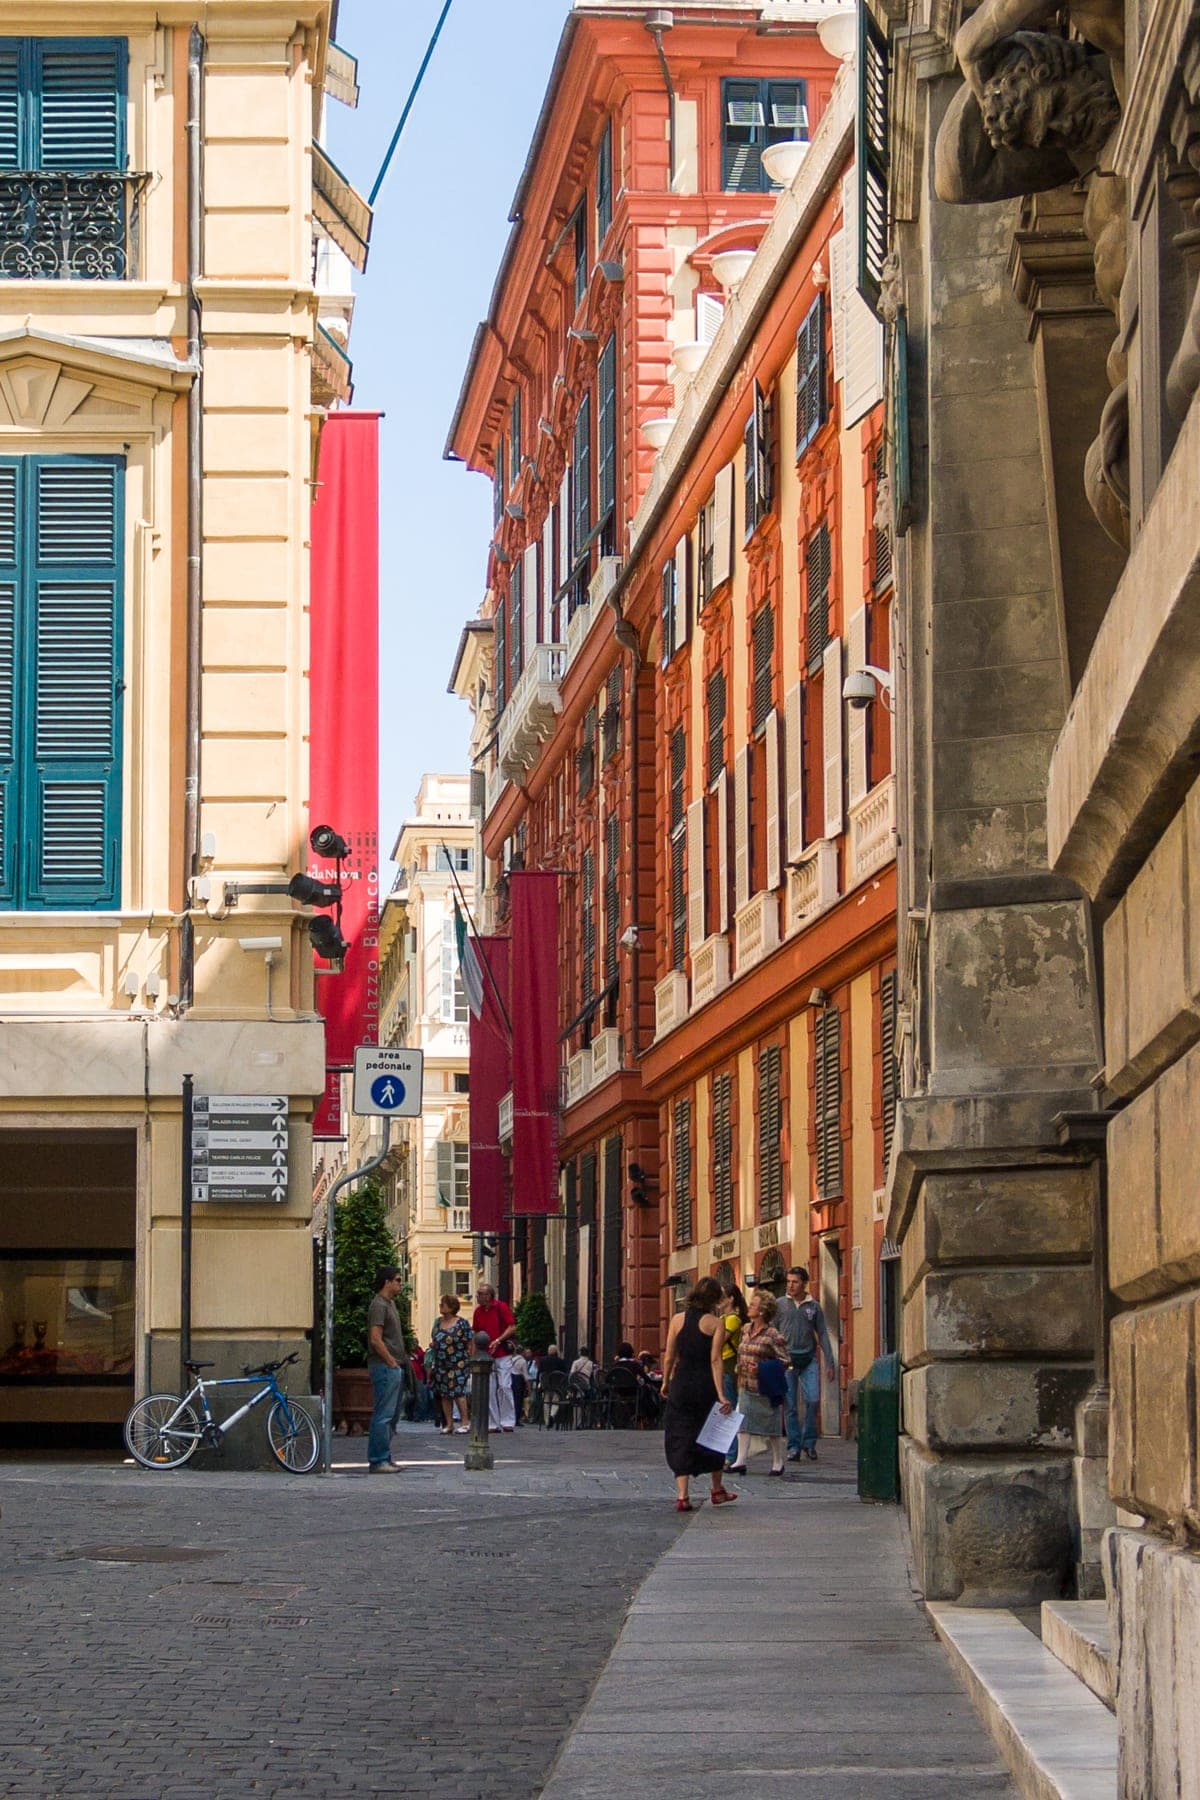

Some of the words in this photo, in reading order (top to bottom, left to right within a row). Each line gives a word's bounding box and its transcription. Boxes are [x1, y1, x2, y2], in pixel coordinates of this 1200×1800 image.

[362, 872, 378, 948] Bianco
[362, 959, 378, 1046] Palazzo
[366, 1062, 411, 1071] pedonale
